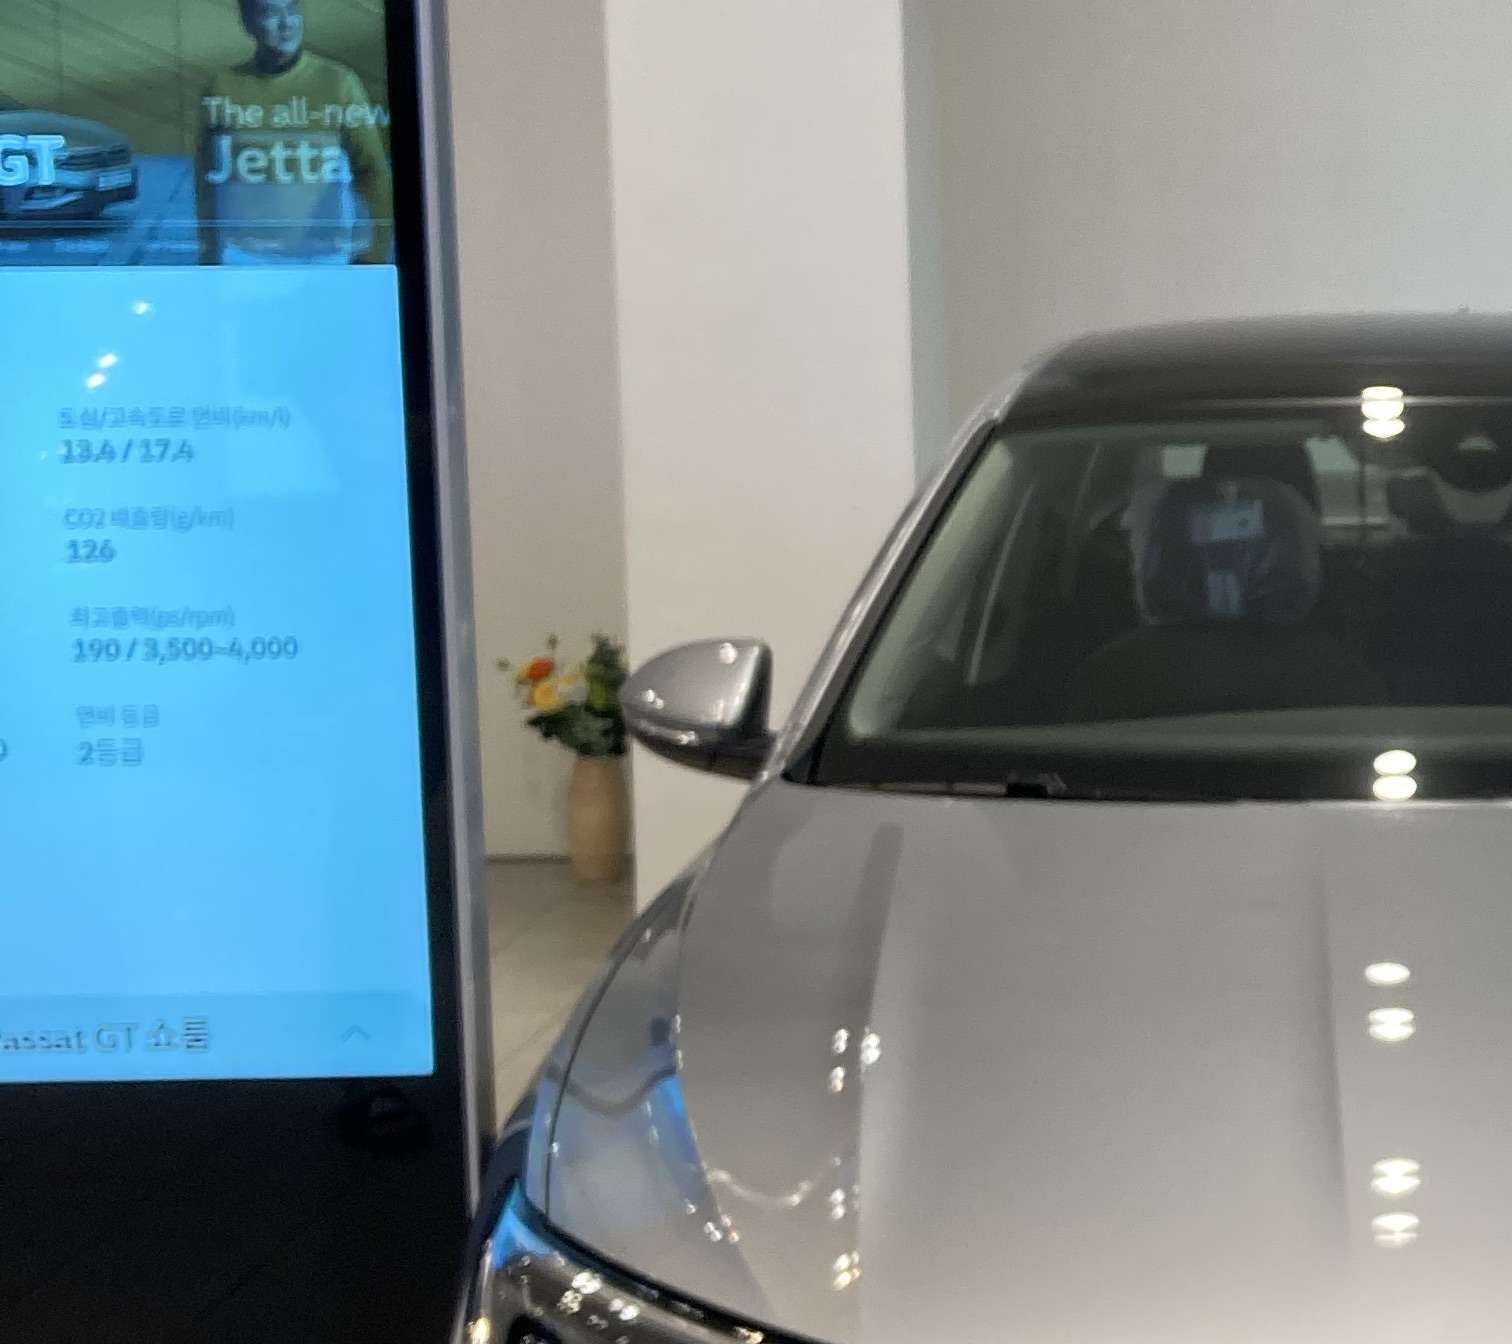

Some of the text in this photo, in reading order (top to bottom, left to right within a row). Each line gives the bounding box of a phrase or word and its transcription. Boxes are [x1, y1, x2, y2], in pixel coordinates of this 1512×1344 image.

[202, 96, 391, 128] The all-new
[205, 135, 353, 185] Jetta
[65, 539, 116, 563] 126
[72, 637, 120, 663] 190
[0, 1027, 86, 1051] assat
